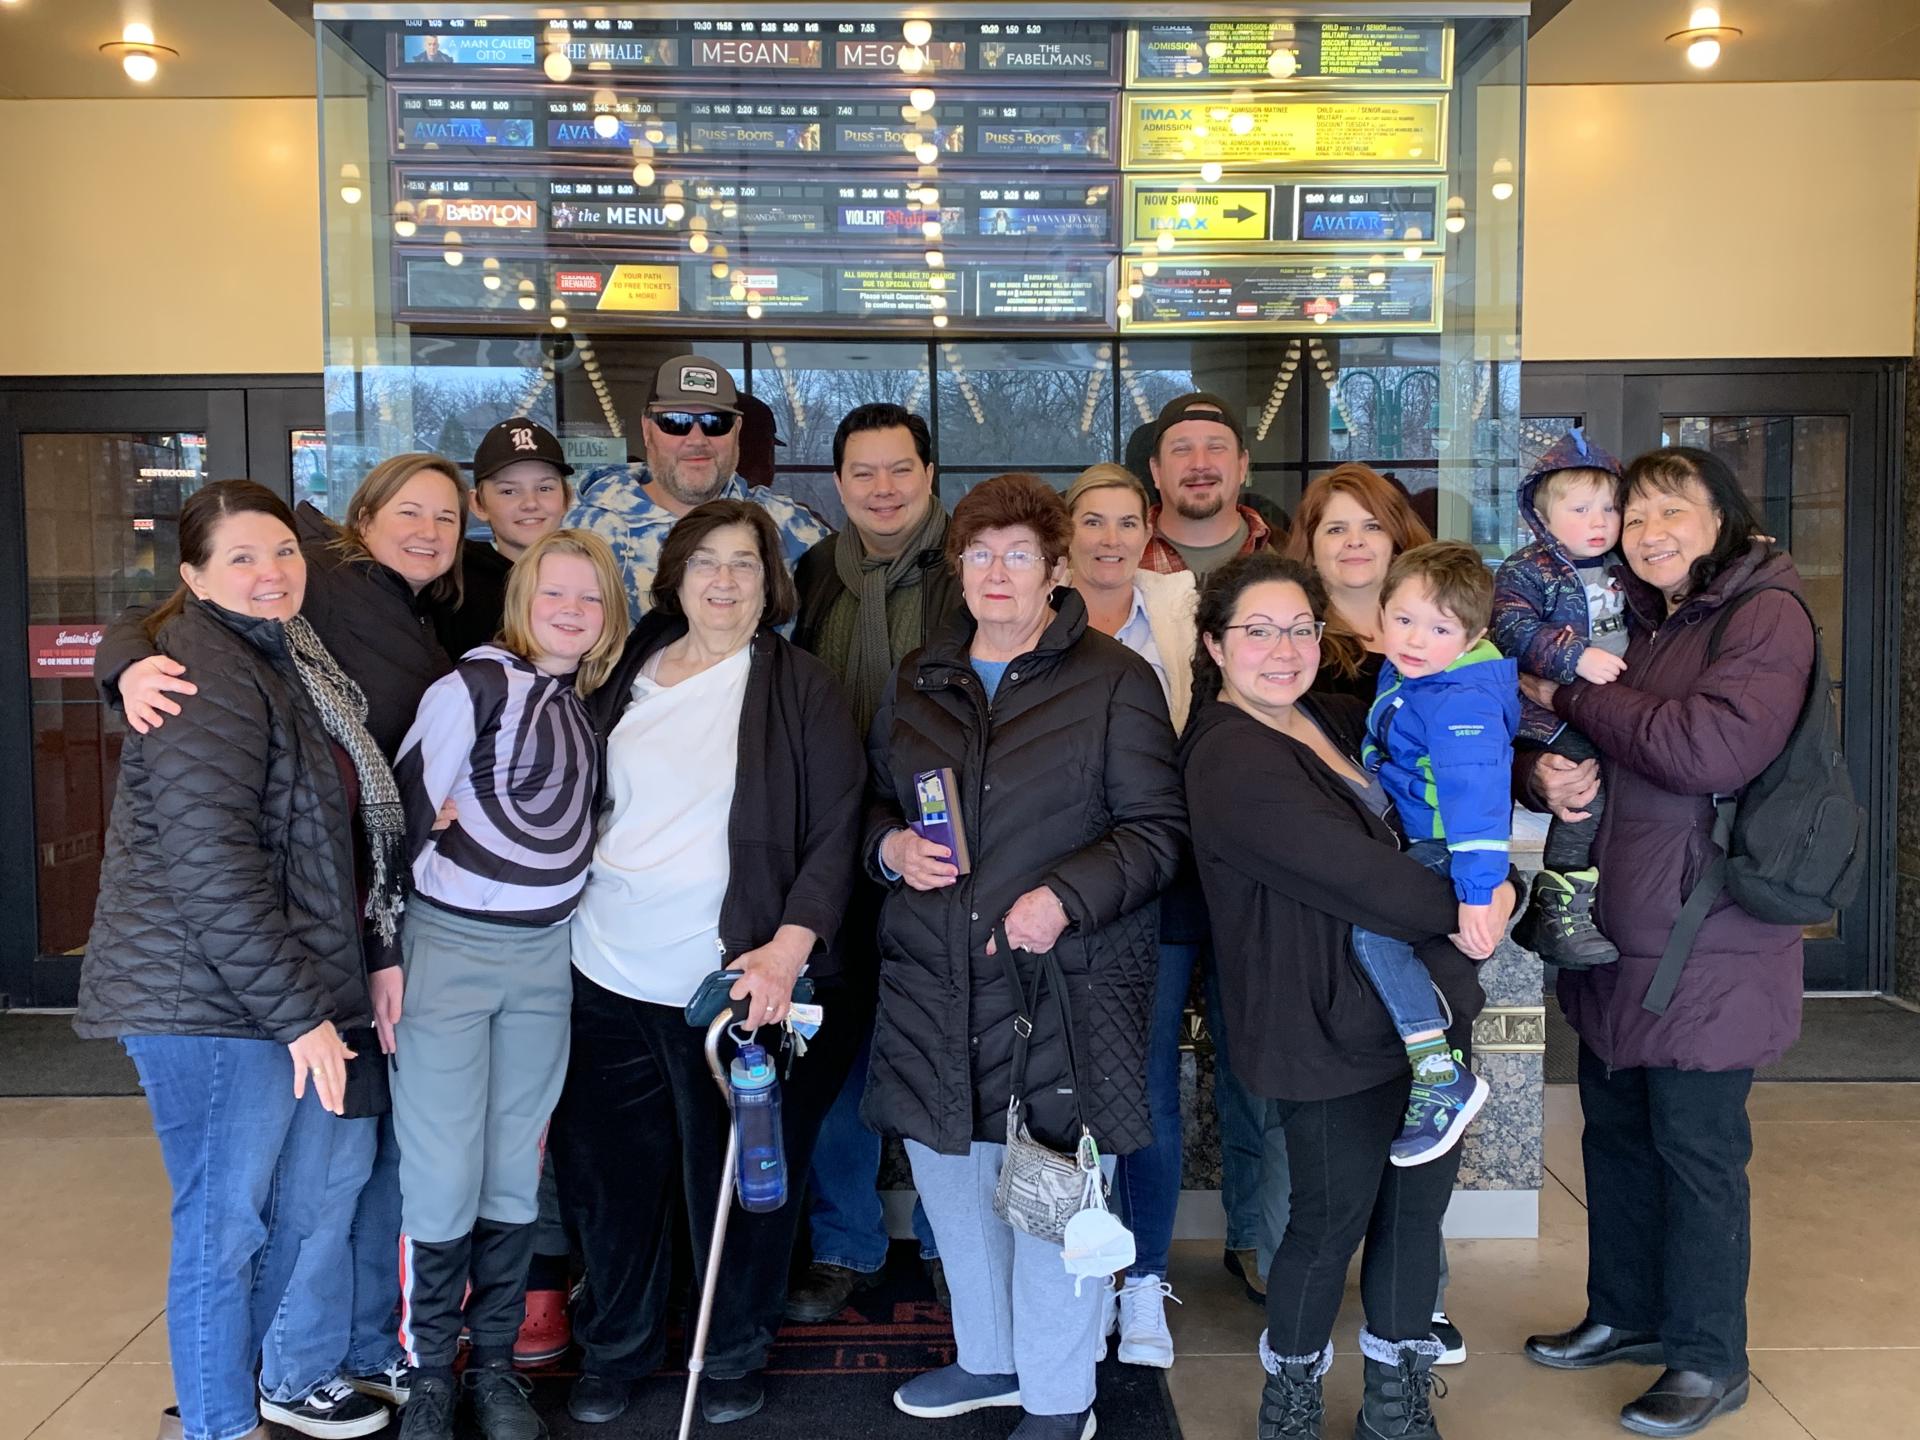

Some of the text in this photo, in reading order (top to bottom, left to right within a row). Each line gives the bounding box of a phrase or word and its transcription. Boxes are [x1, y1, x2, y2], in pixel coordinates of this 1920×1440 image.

[693, 22, 712, 31] 10:30
[1026, 25, 1041, 34] 5:20
[448, 39, 531, 49] A MAN CALLED
[1039, 44, 1060, 53] THE
[1147, 41, 1198, 51] ADMISSION
[1234, 42, 1267, 50] ADMISSION
[476, 50, 506, 60] OTTO
[559, 43, 643, 60] THE WHALE
[1006, 53, 1092, 65] FABELMANS
[1329, 66, 1356, 74] PREMIUM
[450, 101, 464, 110] 3:45
[637, 104, 652, 113] 7:00
[757, 105, 772, 115] 4:05
[780, 106, 795, 116] 5:00
[802, 106, 817, 116] 6:45
[837, 106, 852, 115] 7:40
[1140, 108, 1193, 121] IMAX
[414, 121, 484, 137] AVATAR
[1143, 123, 1193, 131] ADMISSION
[740, 187, 756, 197] 7:00
[1144, 195, 1169, 206] NOW
[446, 204, 532, 221] BABYLON
[578, 207, 667, 225] the MENU
[845, 209, 886, 226] VIOLENT
[1150, 217, 1208, 230] IMAX
[1311, 213, 1380, 231] AVATAR
[623, 272, 662, 280] YOUR PATH
[844, 271, 856, 279] ALL
[879, 272, 892, 280] ARE
[893, 272, 920, 280] SUBJECT
[921, 273, 930, 281] TO
[642, 282, 671, 290] TICKETS
[876, 280, 884, 288] TO
[885, 281, 911, 289] SPECIAL
[162, 436, 171, 447] 7
[509, 427, 538, 451] R
[567, 441, 608, 457] PLEASE:
[139, 468, 197, 478] RESTROOMS
[56, 657, 73, 666] MORE
